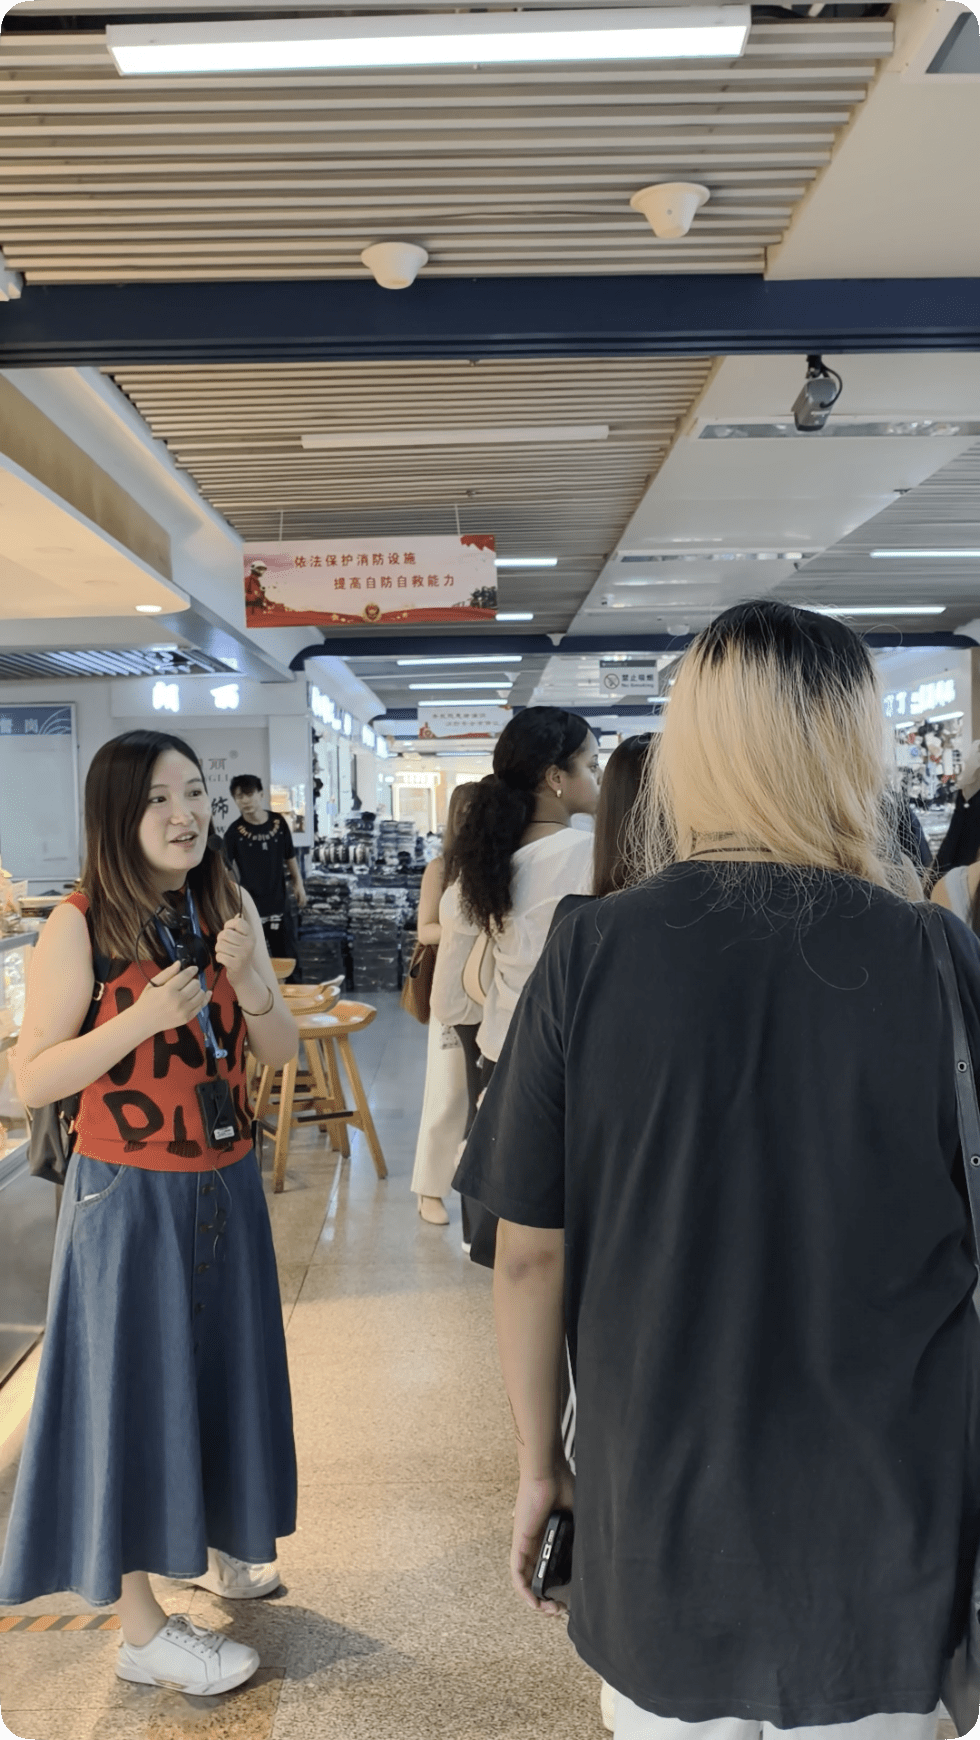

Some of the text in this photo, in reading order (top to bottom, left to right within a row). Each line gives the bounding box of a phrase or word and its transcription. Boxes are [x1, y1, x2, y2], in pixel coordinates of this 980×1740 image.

[294, 552, 416, 568] 依法保护消防设施
[334, 574, 454, 590] 提高自防自救能力
